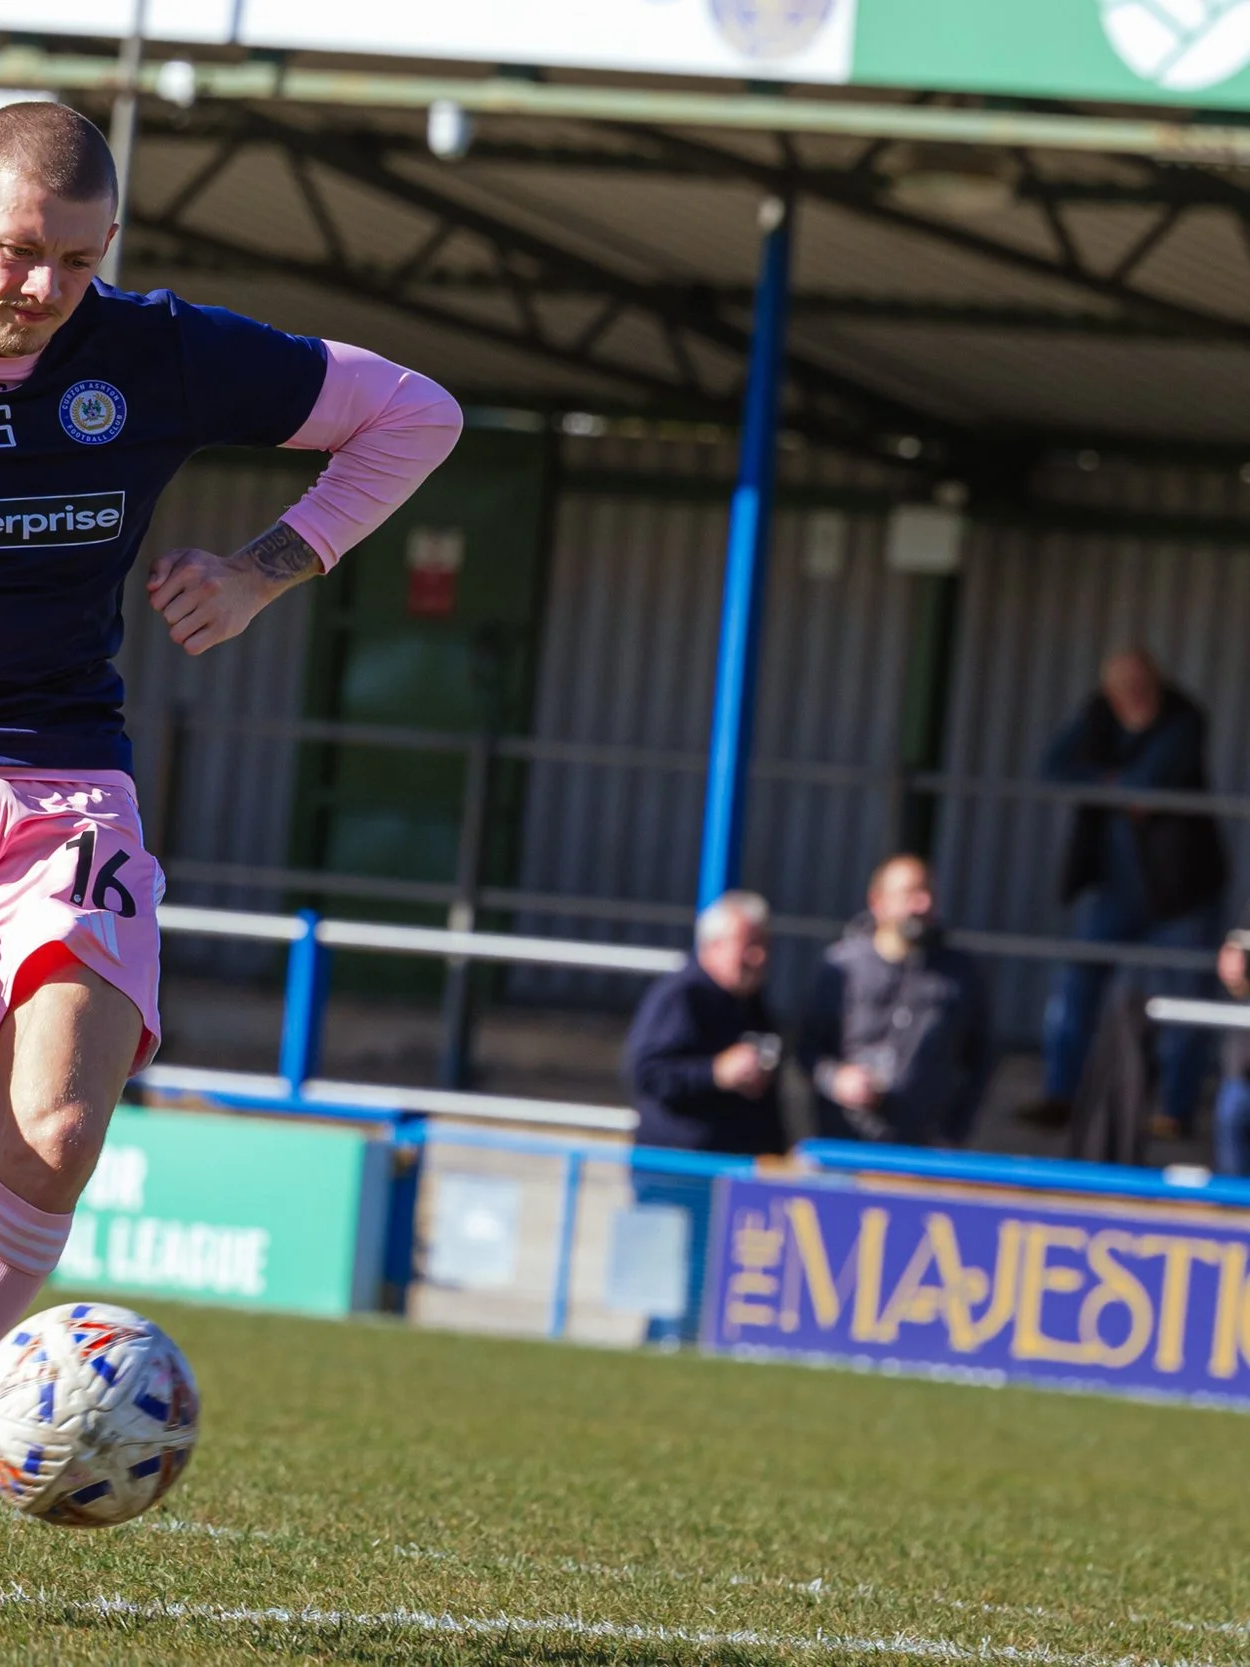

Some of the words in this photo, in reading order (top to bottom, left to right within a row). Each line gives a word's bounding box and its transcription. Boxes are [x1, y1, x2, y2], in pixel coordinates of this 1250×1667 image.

[62, 383, 86, 410] CURZON
[88, 382, 120, 402] ASHTON
[66, 423, 108, 442] FOOTBALL
[108, 414, 123, 435] CLUB
[65, 830, 137, 918] 16
[770, 1195, 1250, 1380] MAJESTI
